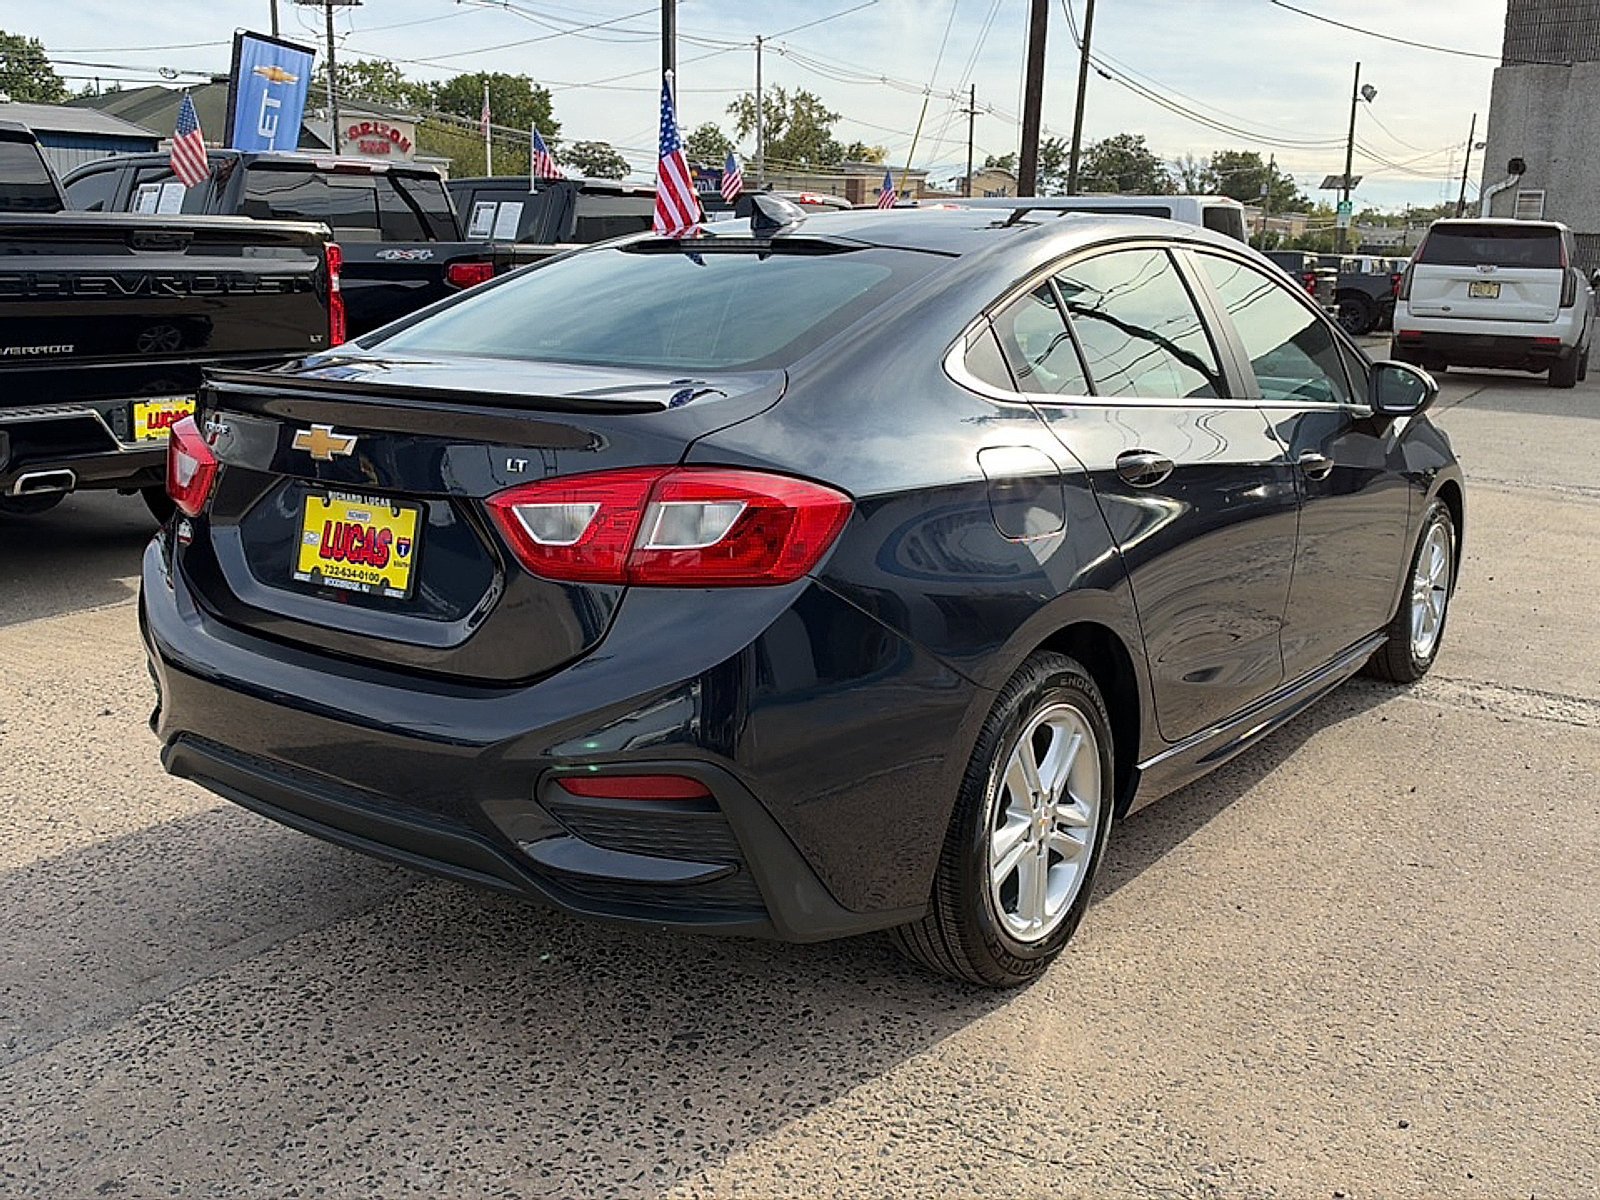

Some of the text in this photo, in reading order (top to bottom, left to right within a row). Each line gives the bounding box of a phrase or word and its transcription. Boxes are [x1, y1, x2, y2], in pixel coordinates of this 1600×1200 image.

[310, 335, 323, 343] LT
[507, 458, 528, 472] LT
[320, 520, 393, 569] LUCAS
[324, 564, 380, 583] 732-634-0100
